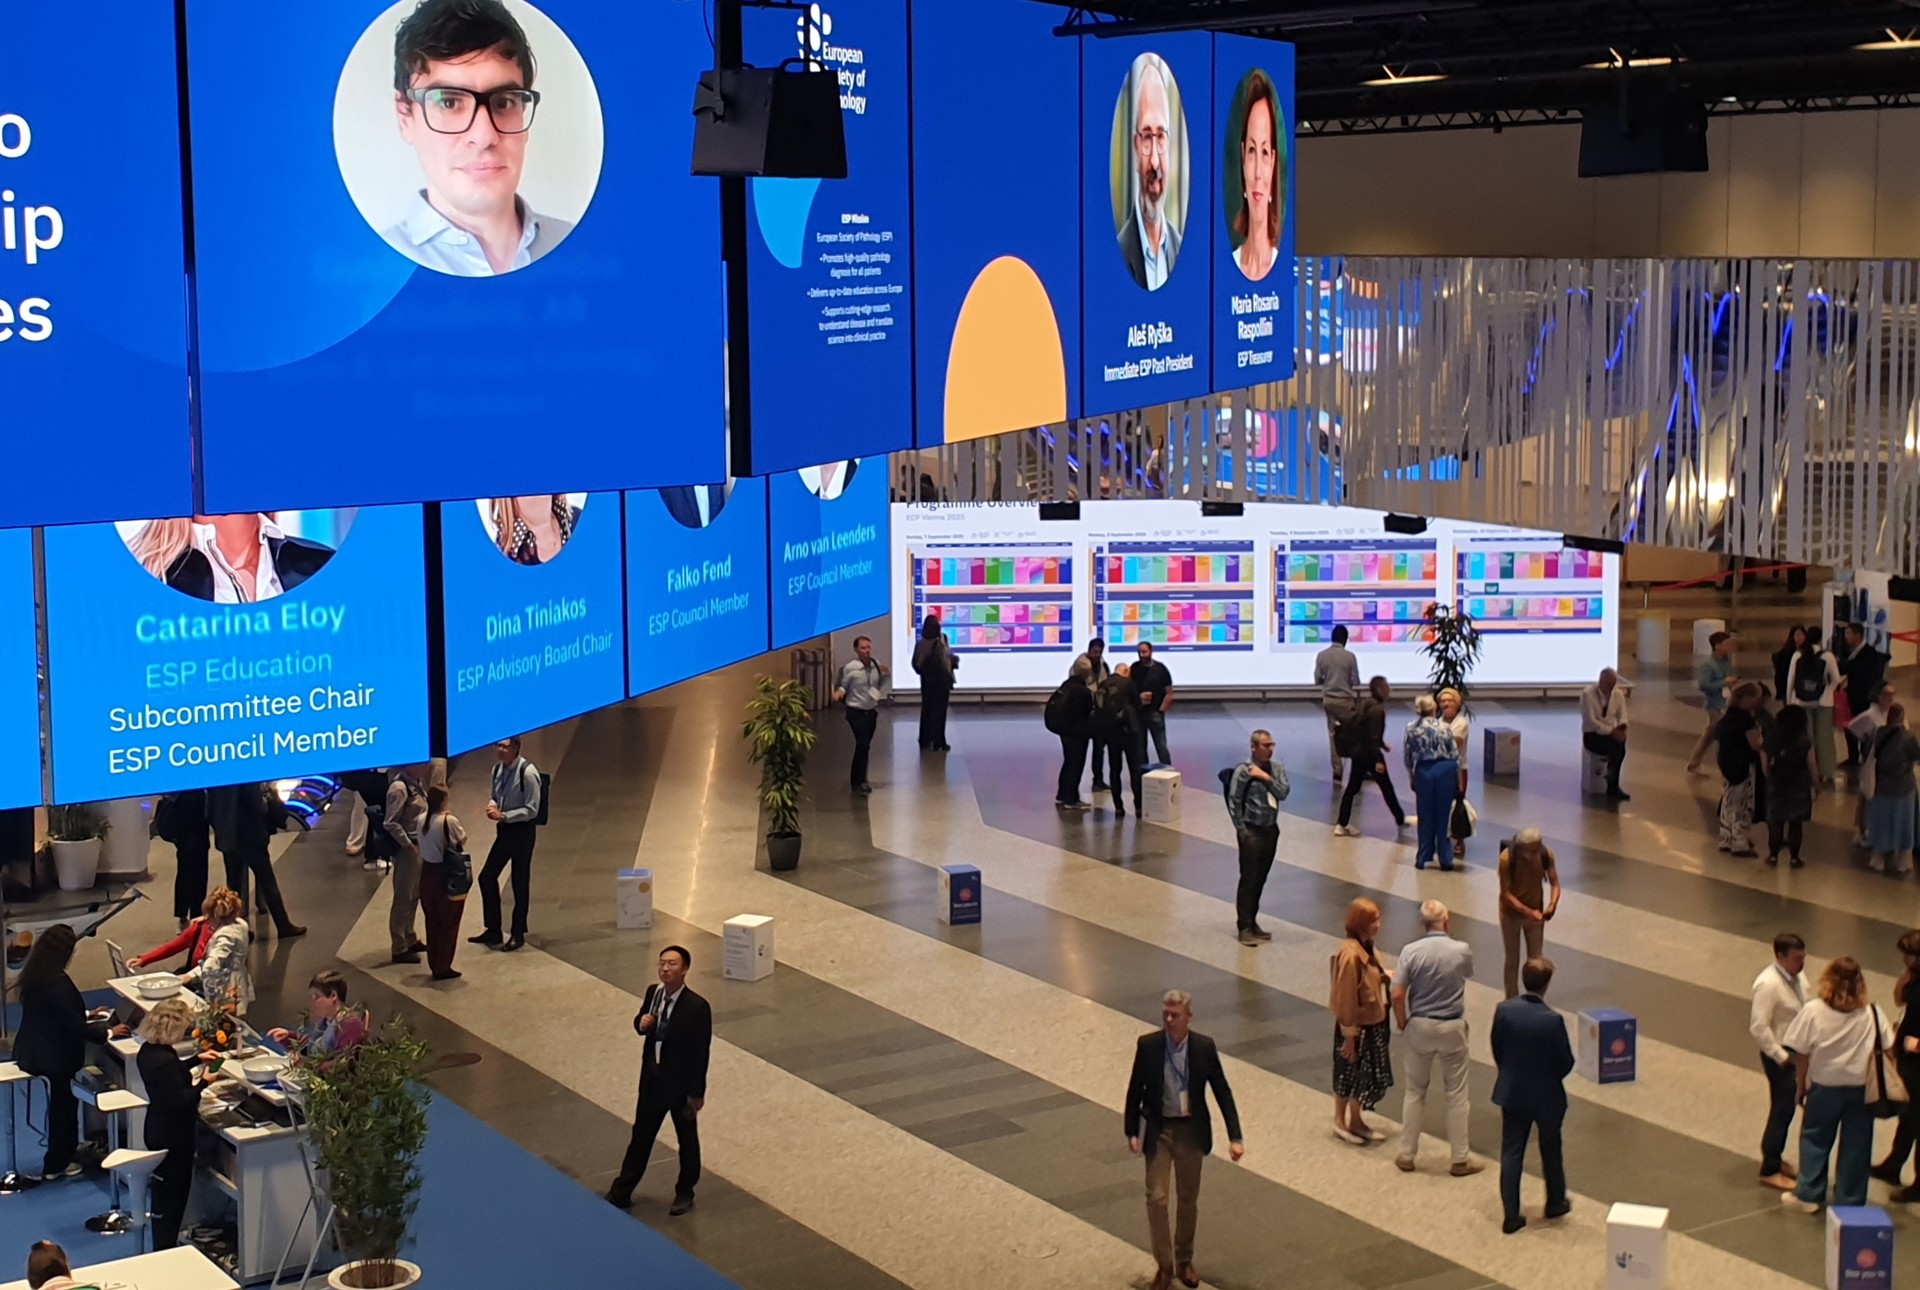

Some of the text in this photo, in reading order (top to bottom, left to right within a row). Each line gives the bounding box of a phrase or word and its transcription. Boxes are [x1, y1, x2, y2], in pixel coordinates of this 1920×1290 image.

[823, 42, 863, 66] European
[837, 67, 866, 91] iety of
[1231, 290, 1280, 315] Maria Rosaria
[1237, 315, 1273, 342] Raspollini
[1104, 353, 1194, 382] Immediate ESP Past President
[1237, 350, 1273, 368] ESP Treasurer
[986, 500, 1037, 508] Overvie
[783, 524, 876, 563] Arno van Leenders
[667, 554, 732, 594] Falko Fend
[788, 559, 873, 596] ESP Council Member
[135, 600, 347, 643] Catarina Eloy
[485, 596, 587, 643] Dina Tiniakos
[648, 591, 750, 637] ESP Council Member
[145, 650, 333, 690] ESP Education
[457, 631, 613, 693] ESP Advisory Board Chair
[109, 682, 375, 733] Subcommittee Chair
[108, 724, 379, 774] ESP Council Member
